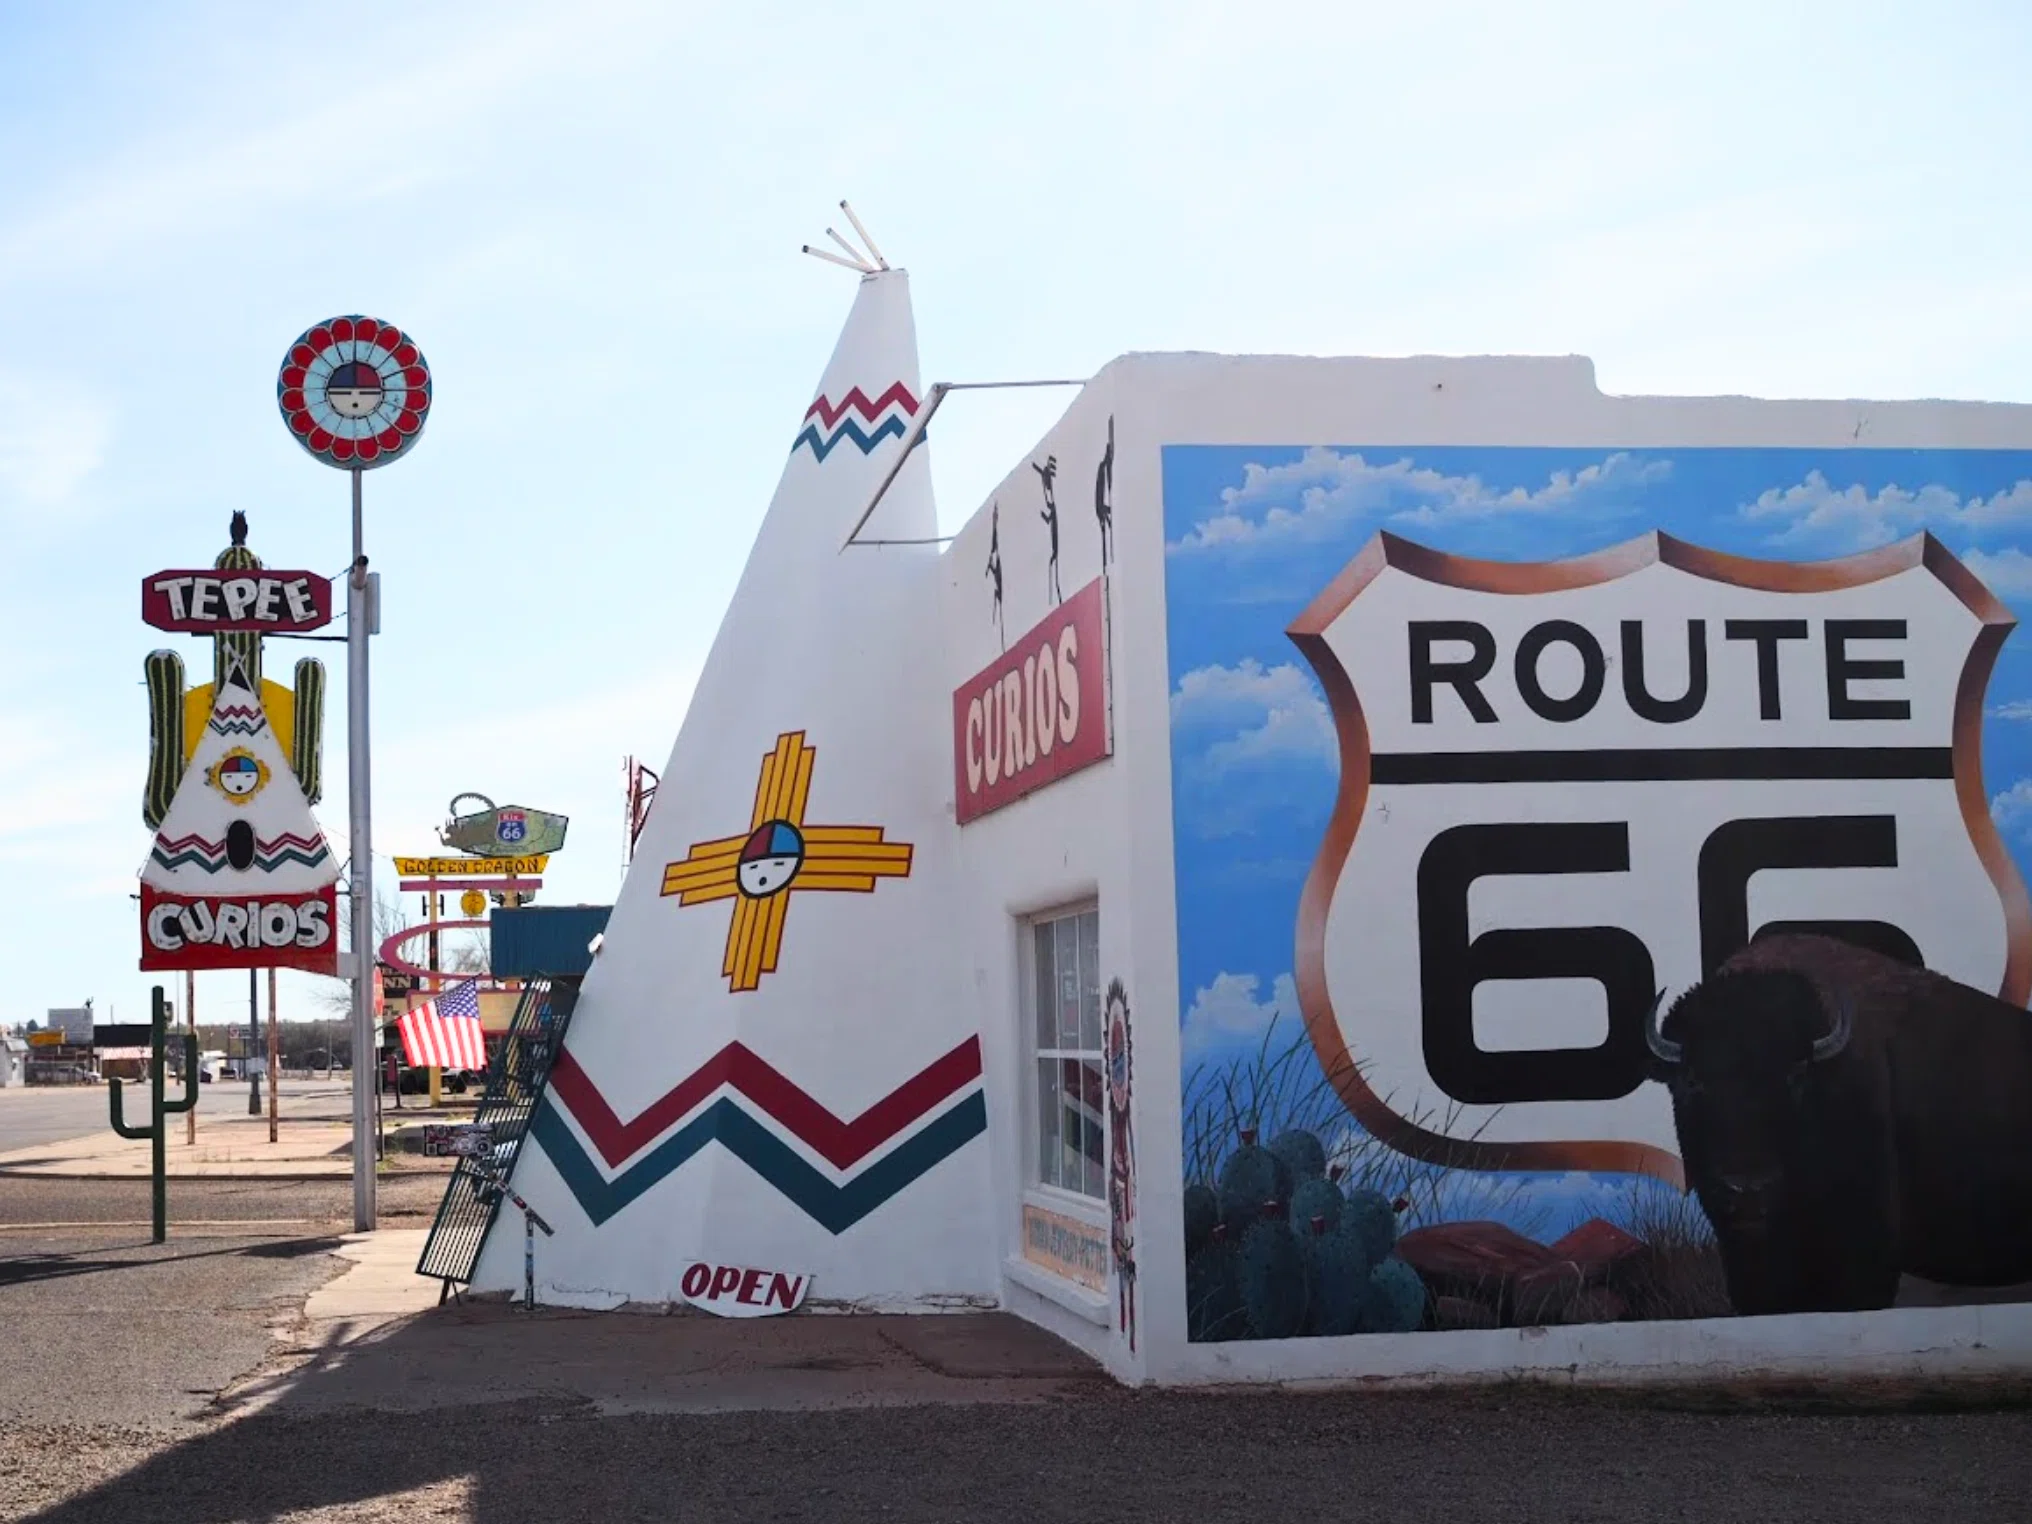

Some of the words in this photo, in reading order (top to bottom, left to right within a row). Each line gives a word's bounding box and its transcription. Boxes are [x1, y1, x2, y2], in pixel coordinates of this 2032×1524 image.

[154, 576, 318, 624] TEPEE
[1408, 618, 1911, 724] ROUTE
[966, 623, 1080, 794] CURIOS
[502, 827, 522, 840] 66
[404, 859, 467, 873] GOLDEN
[474, 857, 539, 874] DRAGON
[147, 900, 330, 950] CURIOS
[681, 1263, 802, 1309] OPEN
